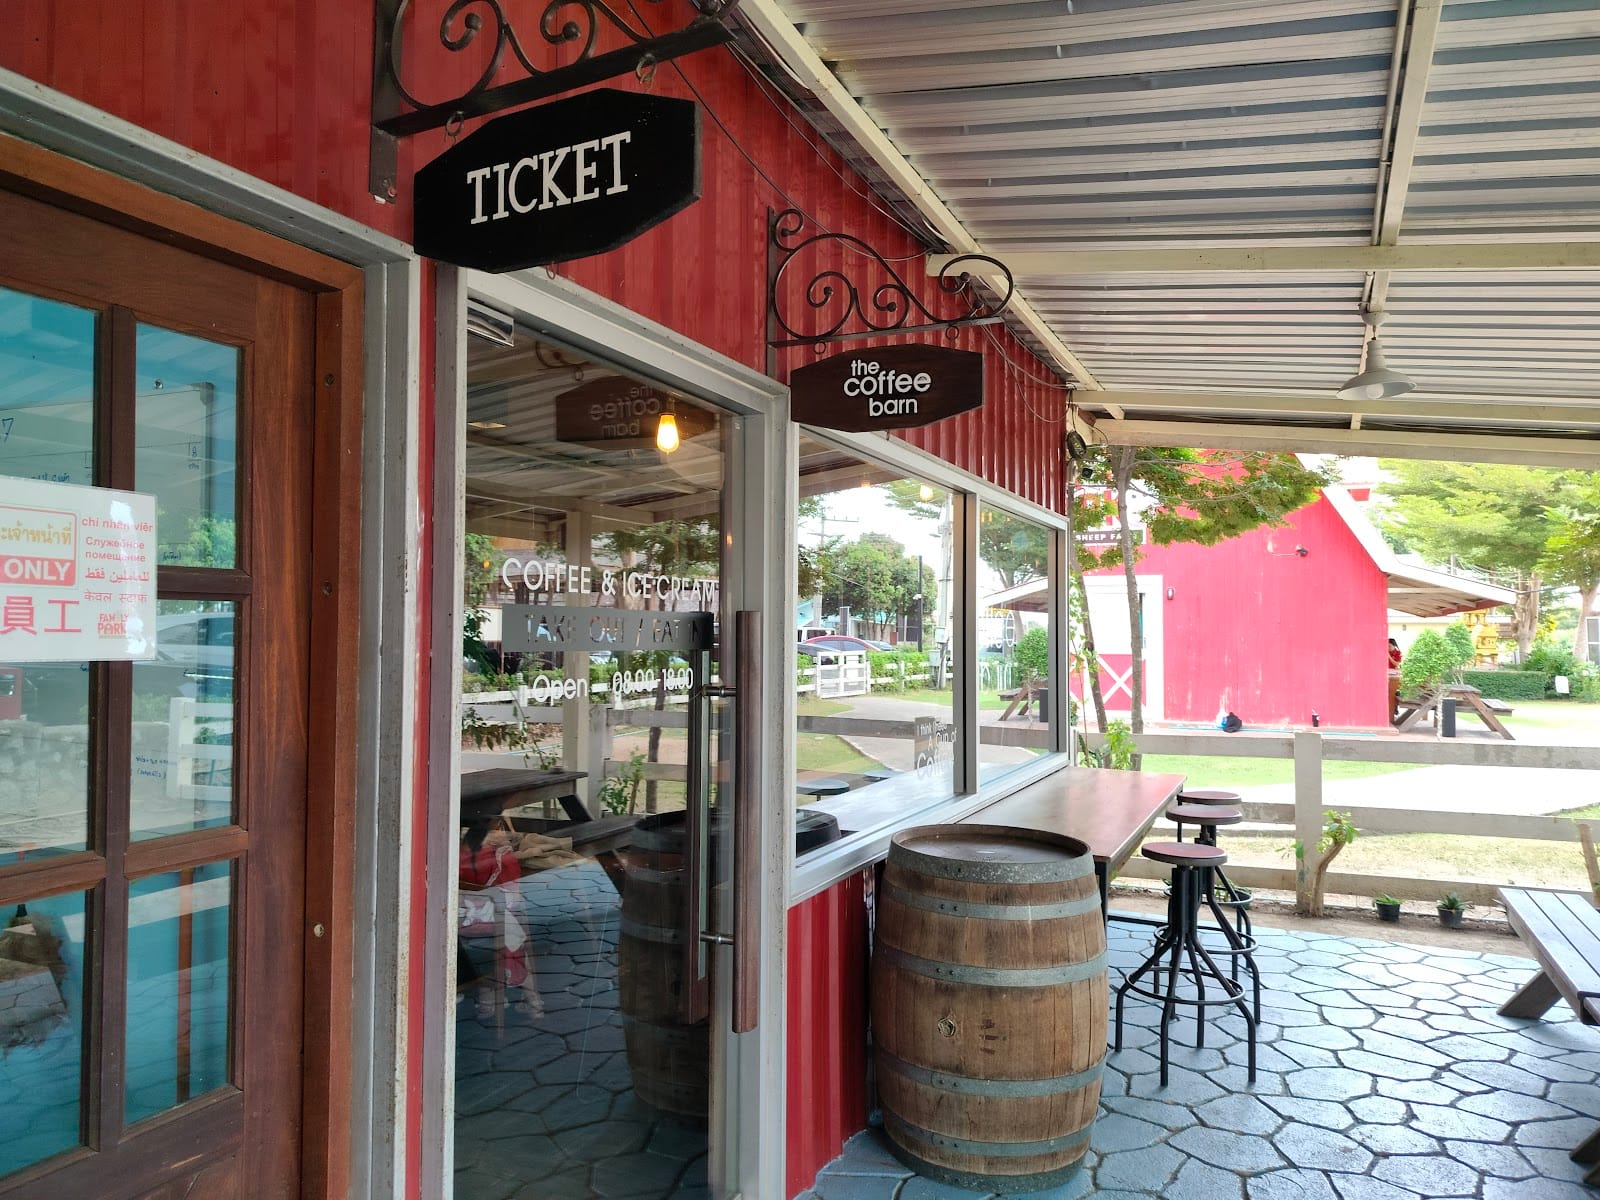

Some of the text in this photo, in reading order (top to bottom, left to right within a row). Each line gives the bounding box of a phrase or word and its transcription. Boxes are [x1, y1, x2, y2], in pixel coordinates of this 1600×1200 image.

[467, 131, 631, 225] TICKET
[851, 359, 880, 376] the
[843, 370, 932, 397] coffee
[869, 397, 918, 417] barn
[1075, 533, 1105, 541] SHEEP
[4, 558, 71, 581] ONLY
[502, 557, 591, 594] COFFEE
[601, 570, 616, 597] &
[0, 595, 81, 635] 員工
[524, 613, 577, 643] TAKE
[589, 615, 625, 644] OUT
[652, 618, 682, 644] EAT
[532, 675, 588, 706] Open
